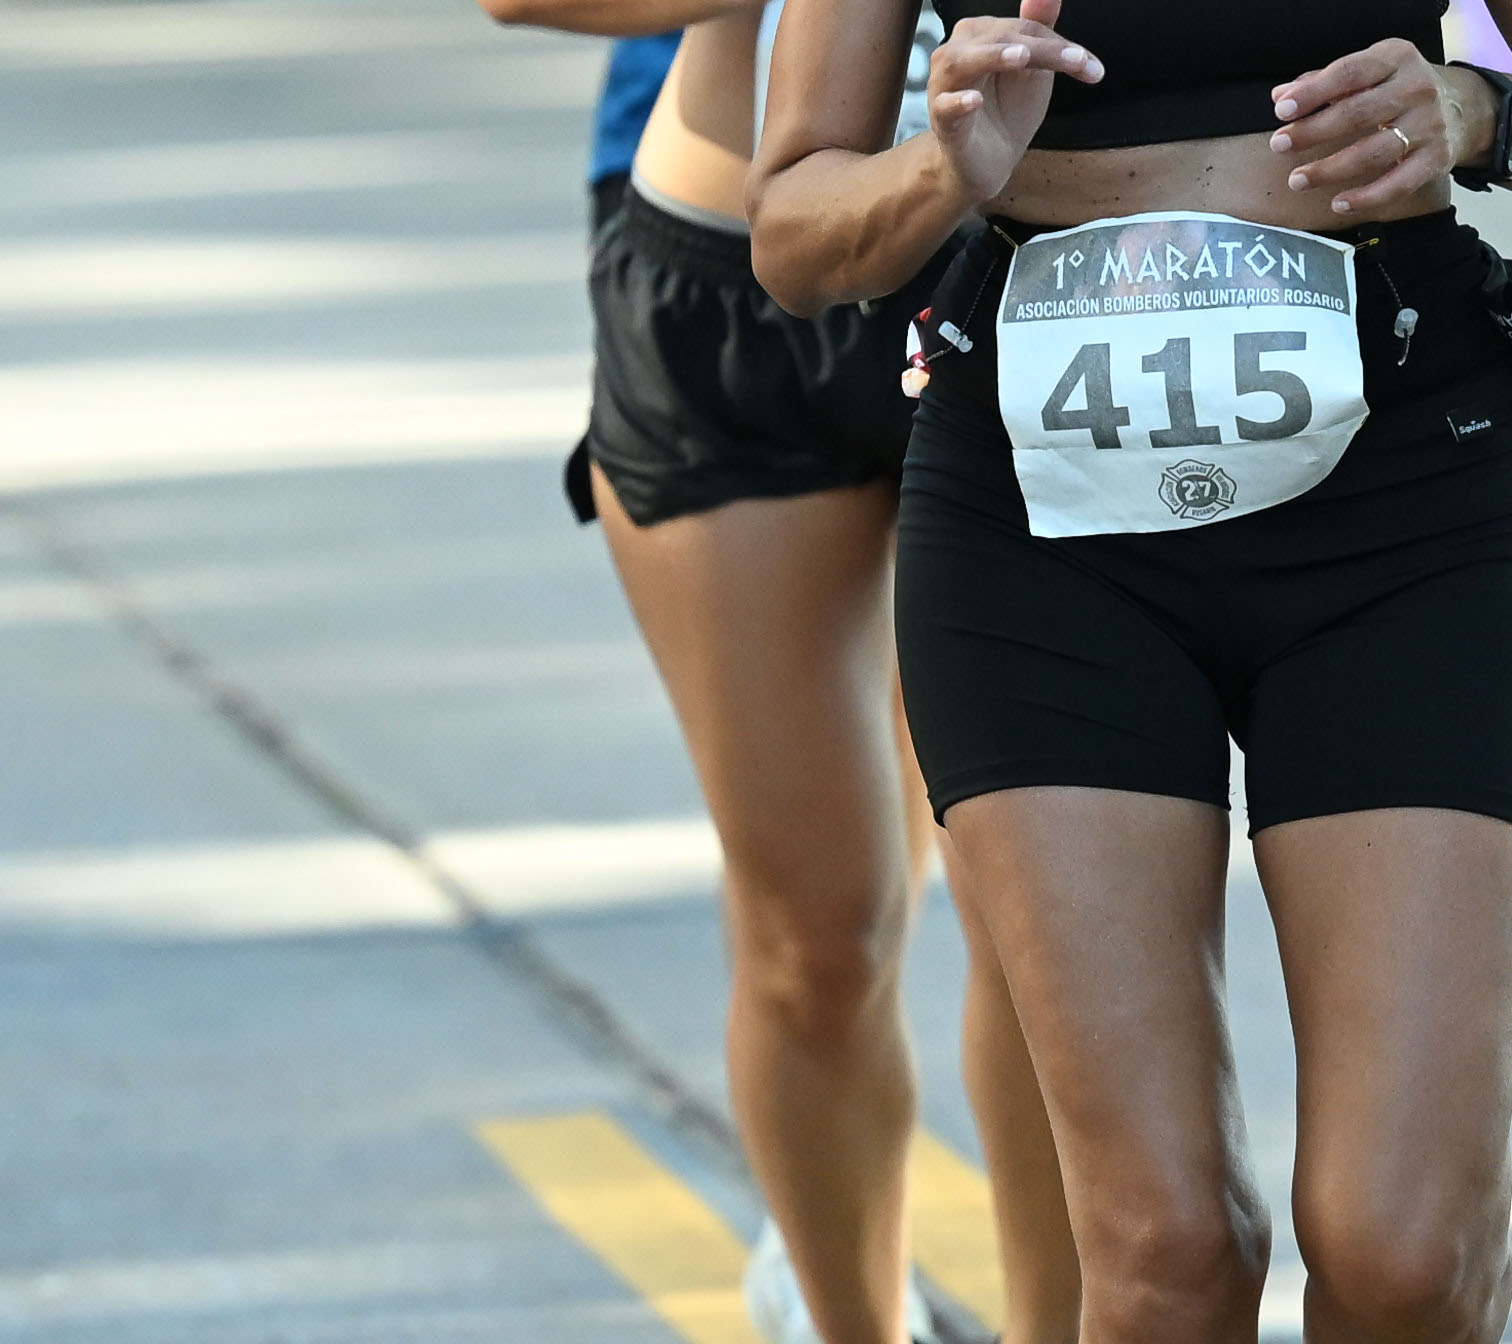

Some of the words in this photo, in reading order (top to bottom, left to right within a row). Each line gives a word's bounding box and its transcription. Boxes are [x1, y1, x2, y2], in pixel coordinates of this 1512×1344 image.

[1099, 234, 1306, 286] MARATÓN
[1016, 296, 1100, 320] ASOCIACIÓN
[1103, 292, 1181, 313] BOMBEROS
[1184, 288, 1280, 307] VOLUNTARIOS
[1284, 289, 1345, 311] ROSARIO
[1041, 331, 1312, 450] 415
[1181, 480, 1212, 502] 27
